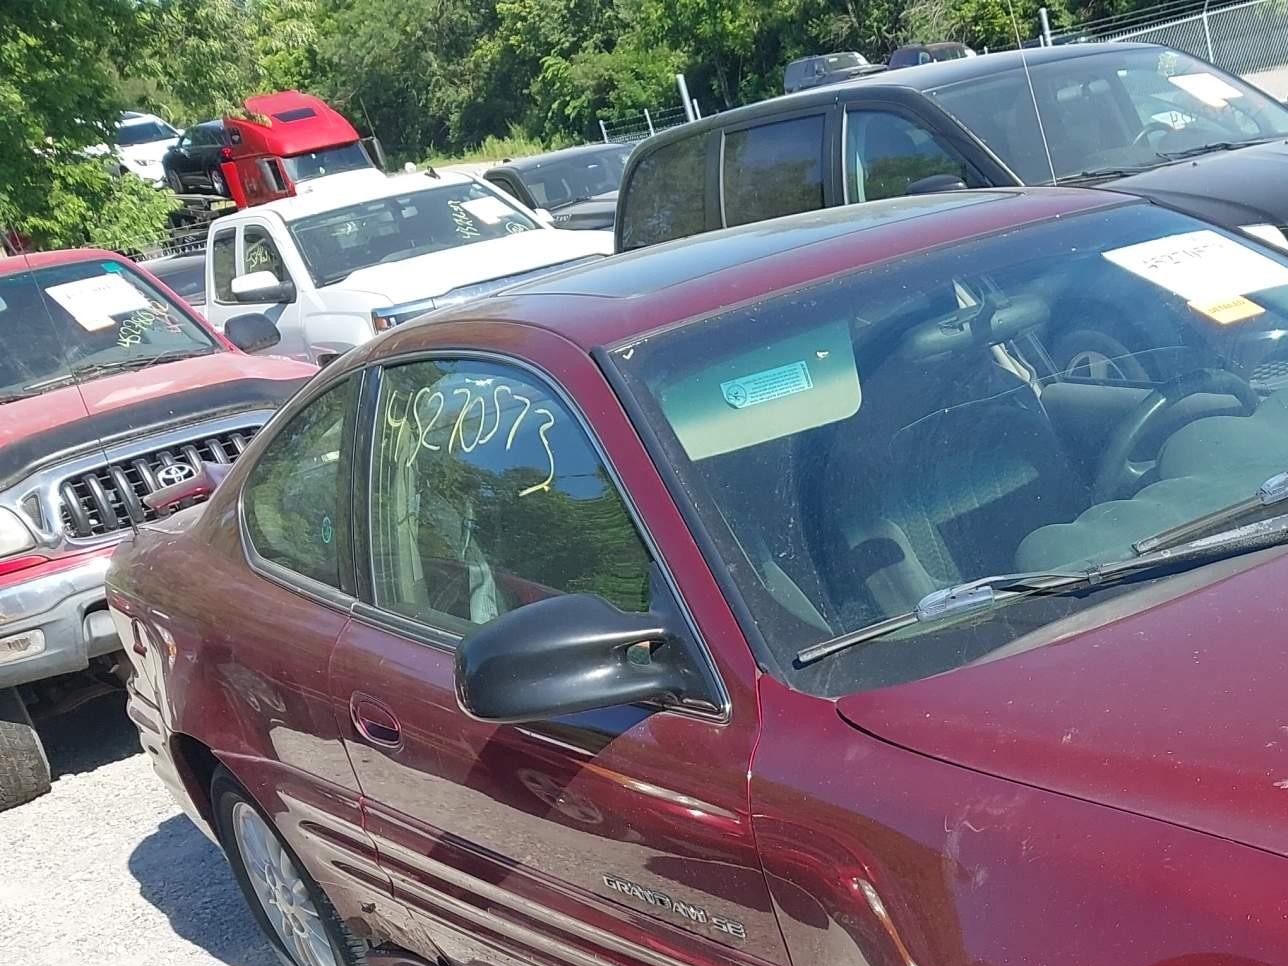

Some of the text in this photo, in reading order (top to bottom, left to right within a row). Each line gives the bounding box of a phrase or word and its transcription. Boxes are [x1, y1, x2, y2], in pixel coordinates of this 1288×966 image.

[387, 385, 555, 496] 45270573
[602, 874, 746, 940] GRAND AM SE
